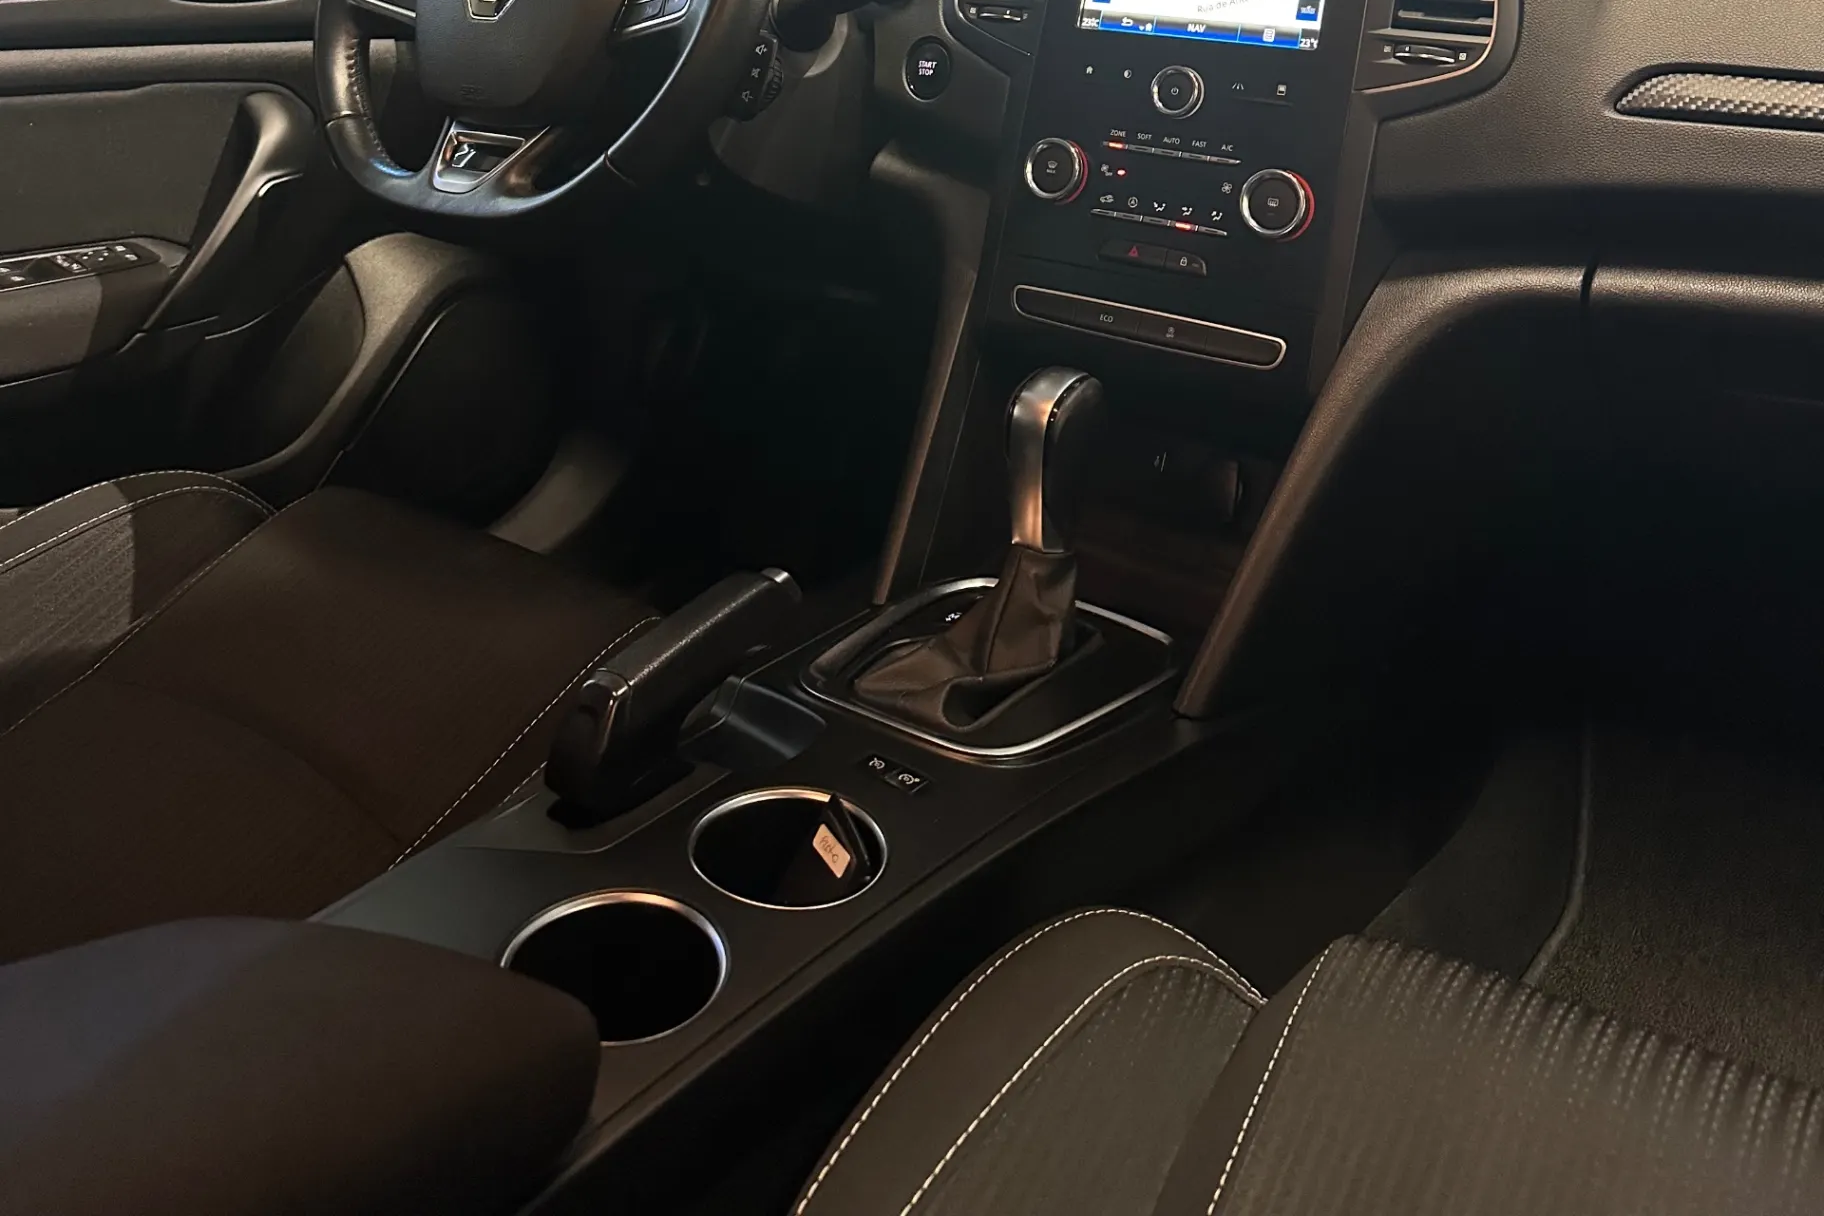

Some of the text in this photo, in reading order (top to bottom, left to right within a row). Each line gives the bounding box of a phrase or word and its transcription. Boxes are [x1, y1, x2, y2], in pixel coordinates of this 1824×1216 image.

[1197, 3, 1214, 14] Rua
[1216, 1, 1228, 10] de
[1187, 23, 1206, 33] NAV
[918, 60, 937, 69] START
[919, 68, 934, 76] STOP
[1110, 129, 1126, 138] ZONE
[1137, 133, 1152, 141] SOFT
[1192, 139, 1207, 148] FAST
[1221, 144, 1234, 152] A/C
[1100, 313, 1114, 323] ECO
